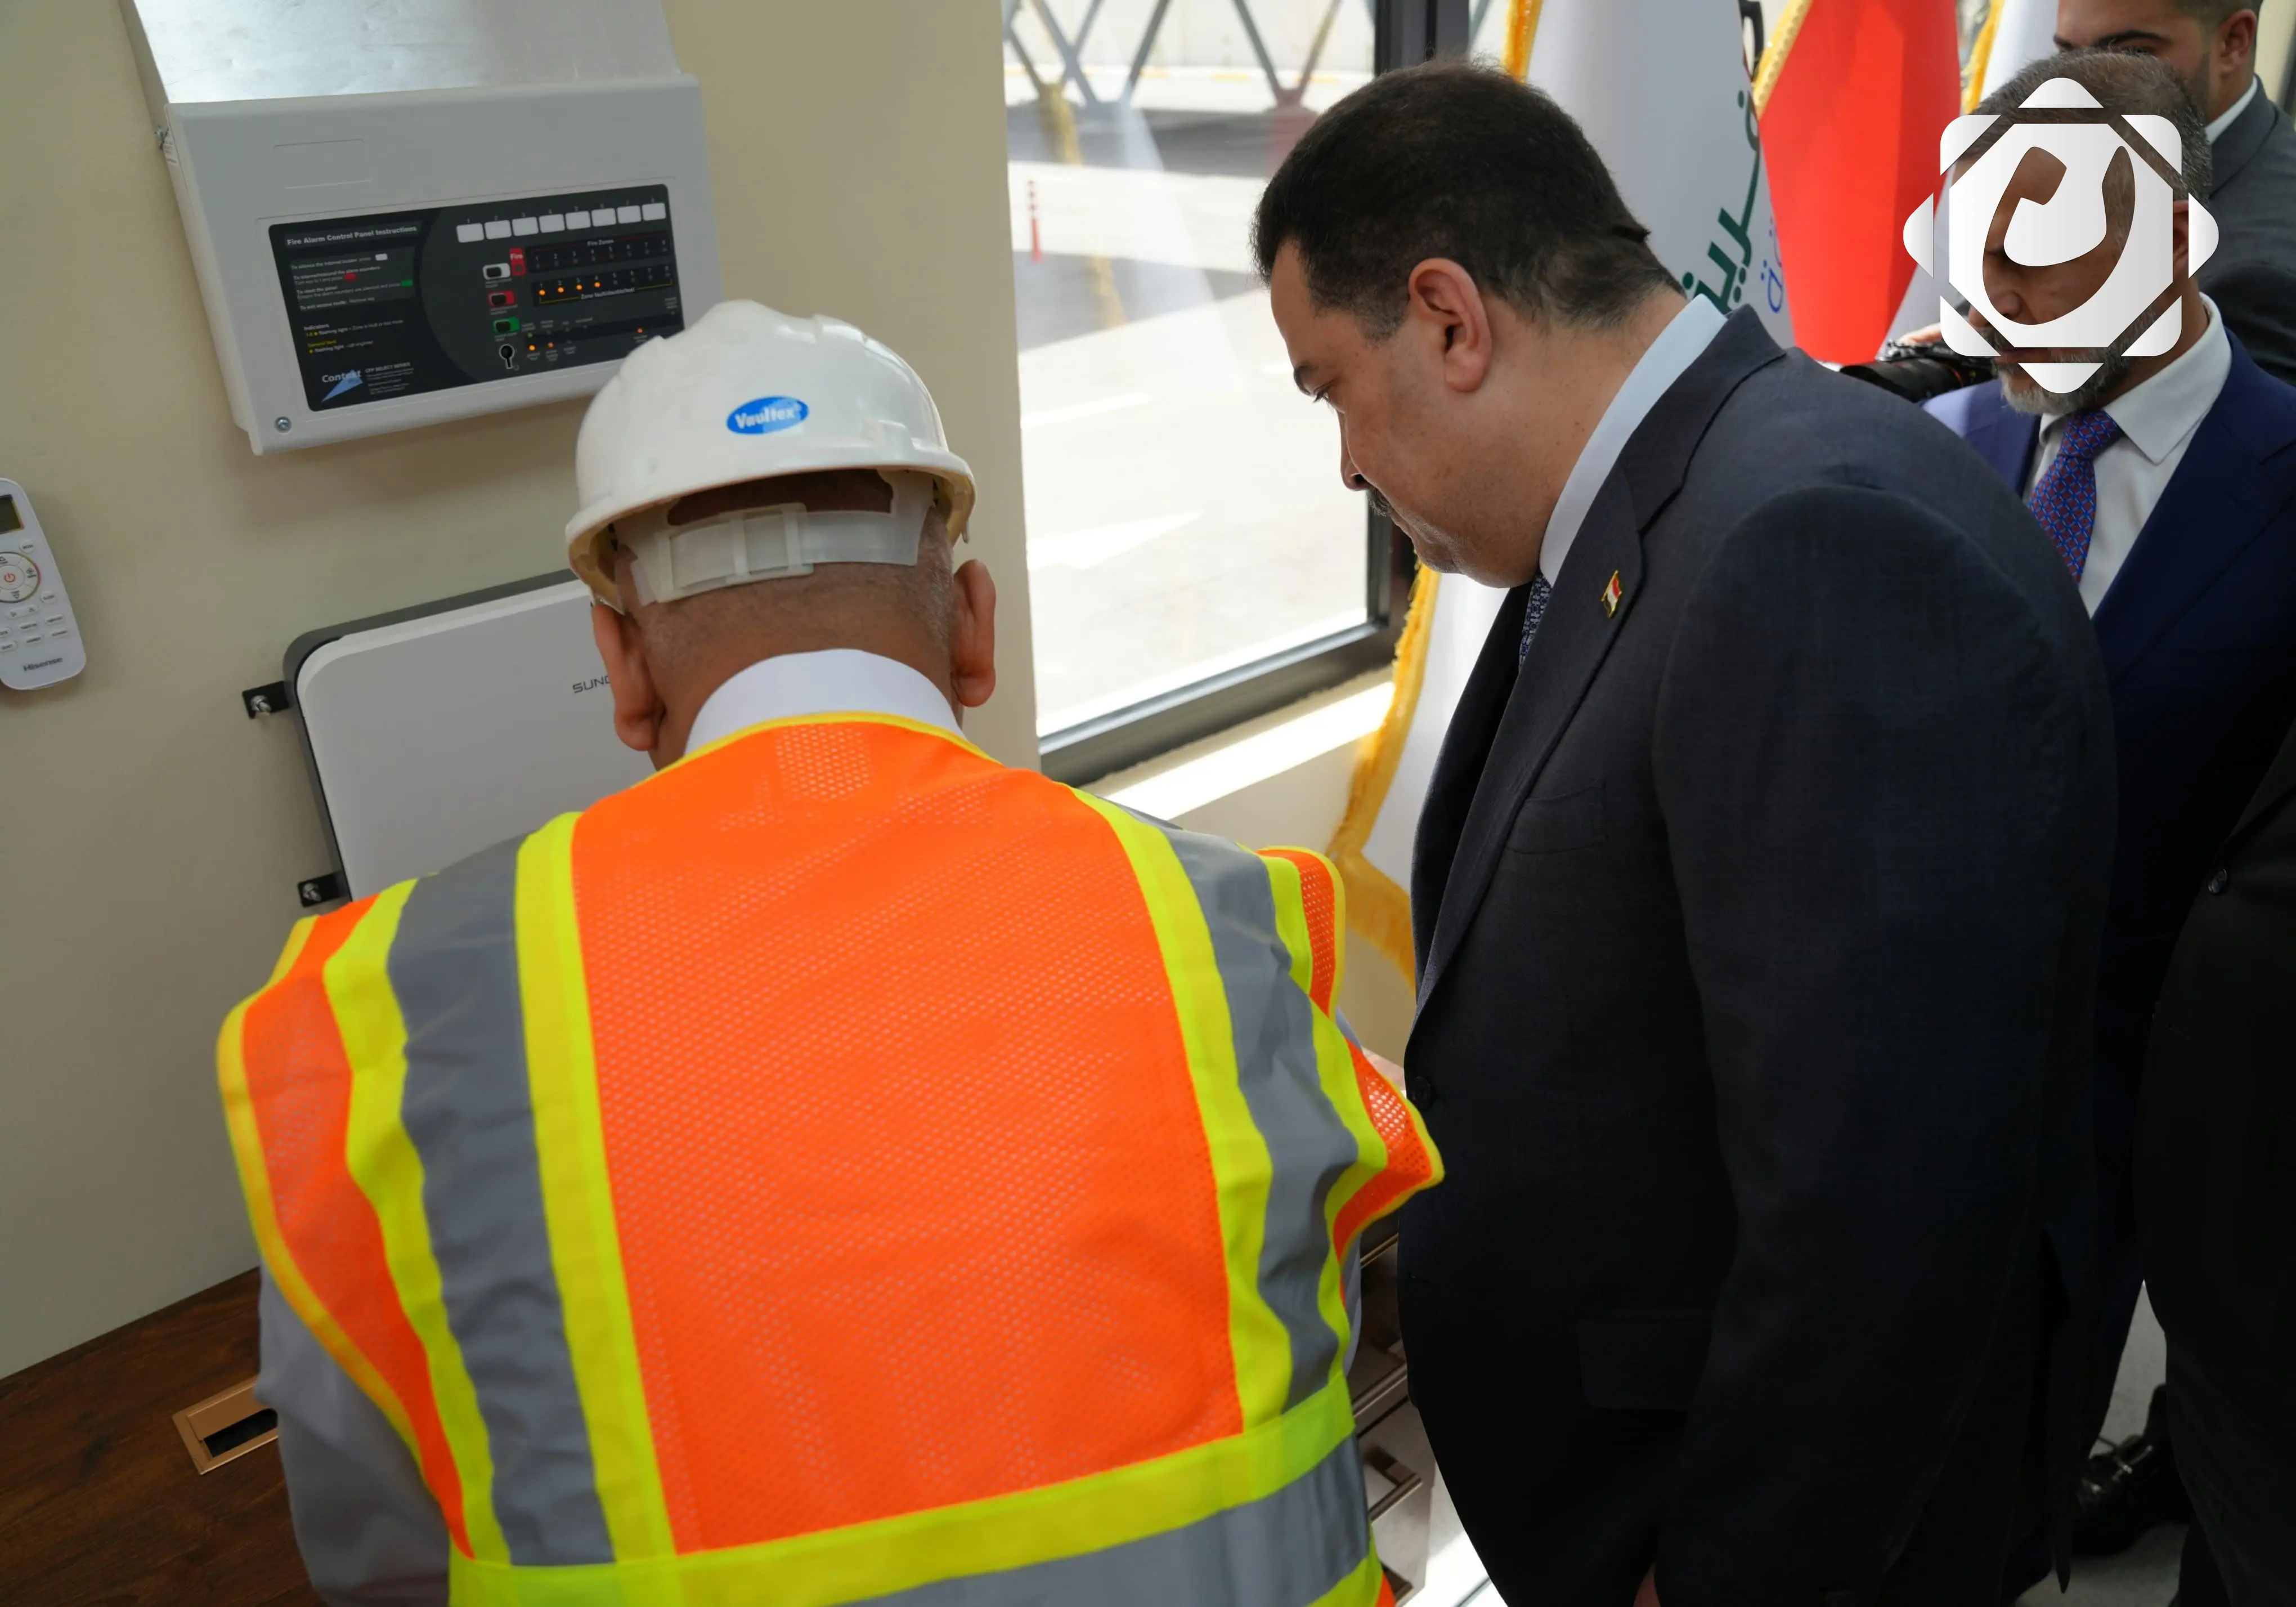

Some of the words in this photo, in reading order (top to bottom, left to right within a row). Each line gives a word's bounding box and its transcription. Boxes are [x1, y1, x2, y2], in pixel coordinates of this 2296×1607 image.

[327, 232, 353, 241] Control
[376, 226, 417, 236] Instructions
[322, 370, 362, 383] Contt
[734, 406, 796, 429] Vaultex
[23, 657, 63, 672] Hisense
